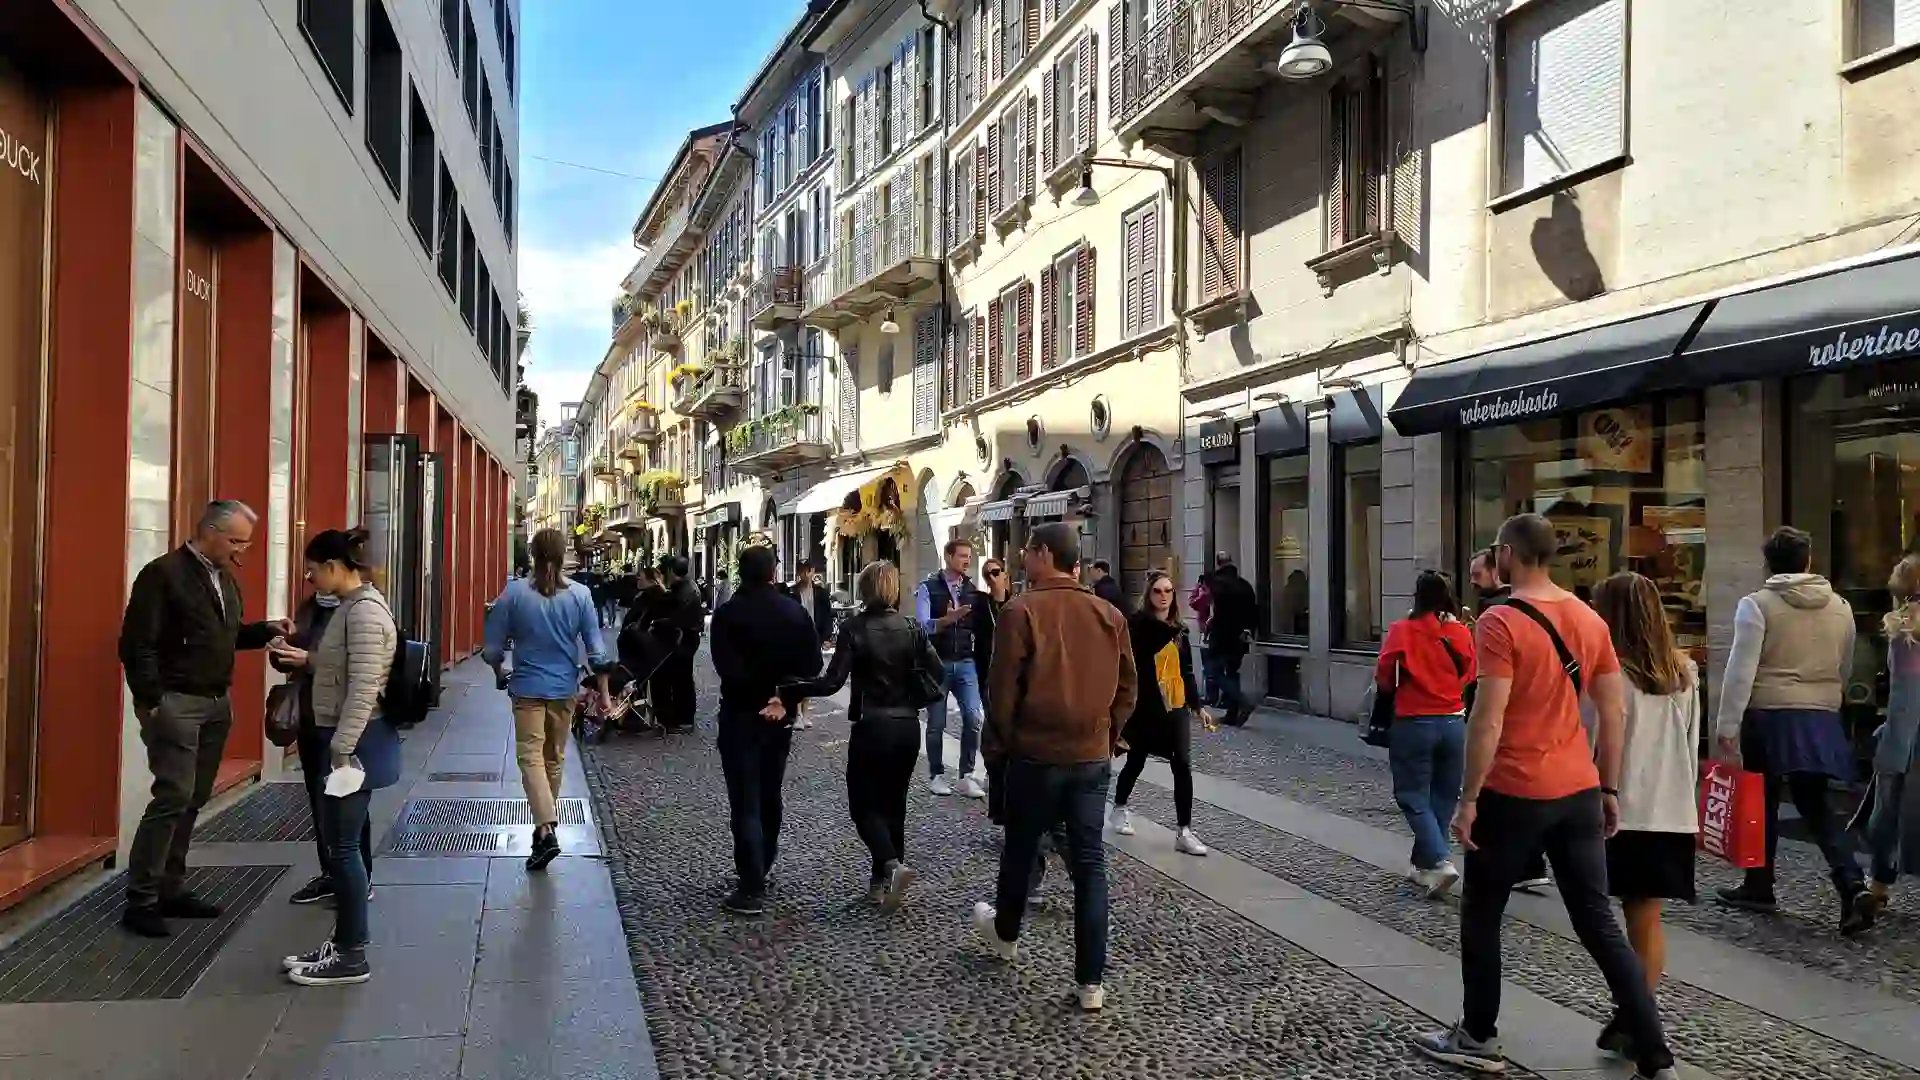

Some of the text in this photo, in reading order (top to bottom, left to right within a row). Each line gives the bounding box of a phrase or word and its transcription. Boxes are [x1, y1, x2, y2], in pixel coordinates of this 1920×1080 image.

[187, 268, 211, 304] DUCK
[1460, 387, 1558, 425] robertaebasta
[1703, 774, 1732, 856] DIESEL
